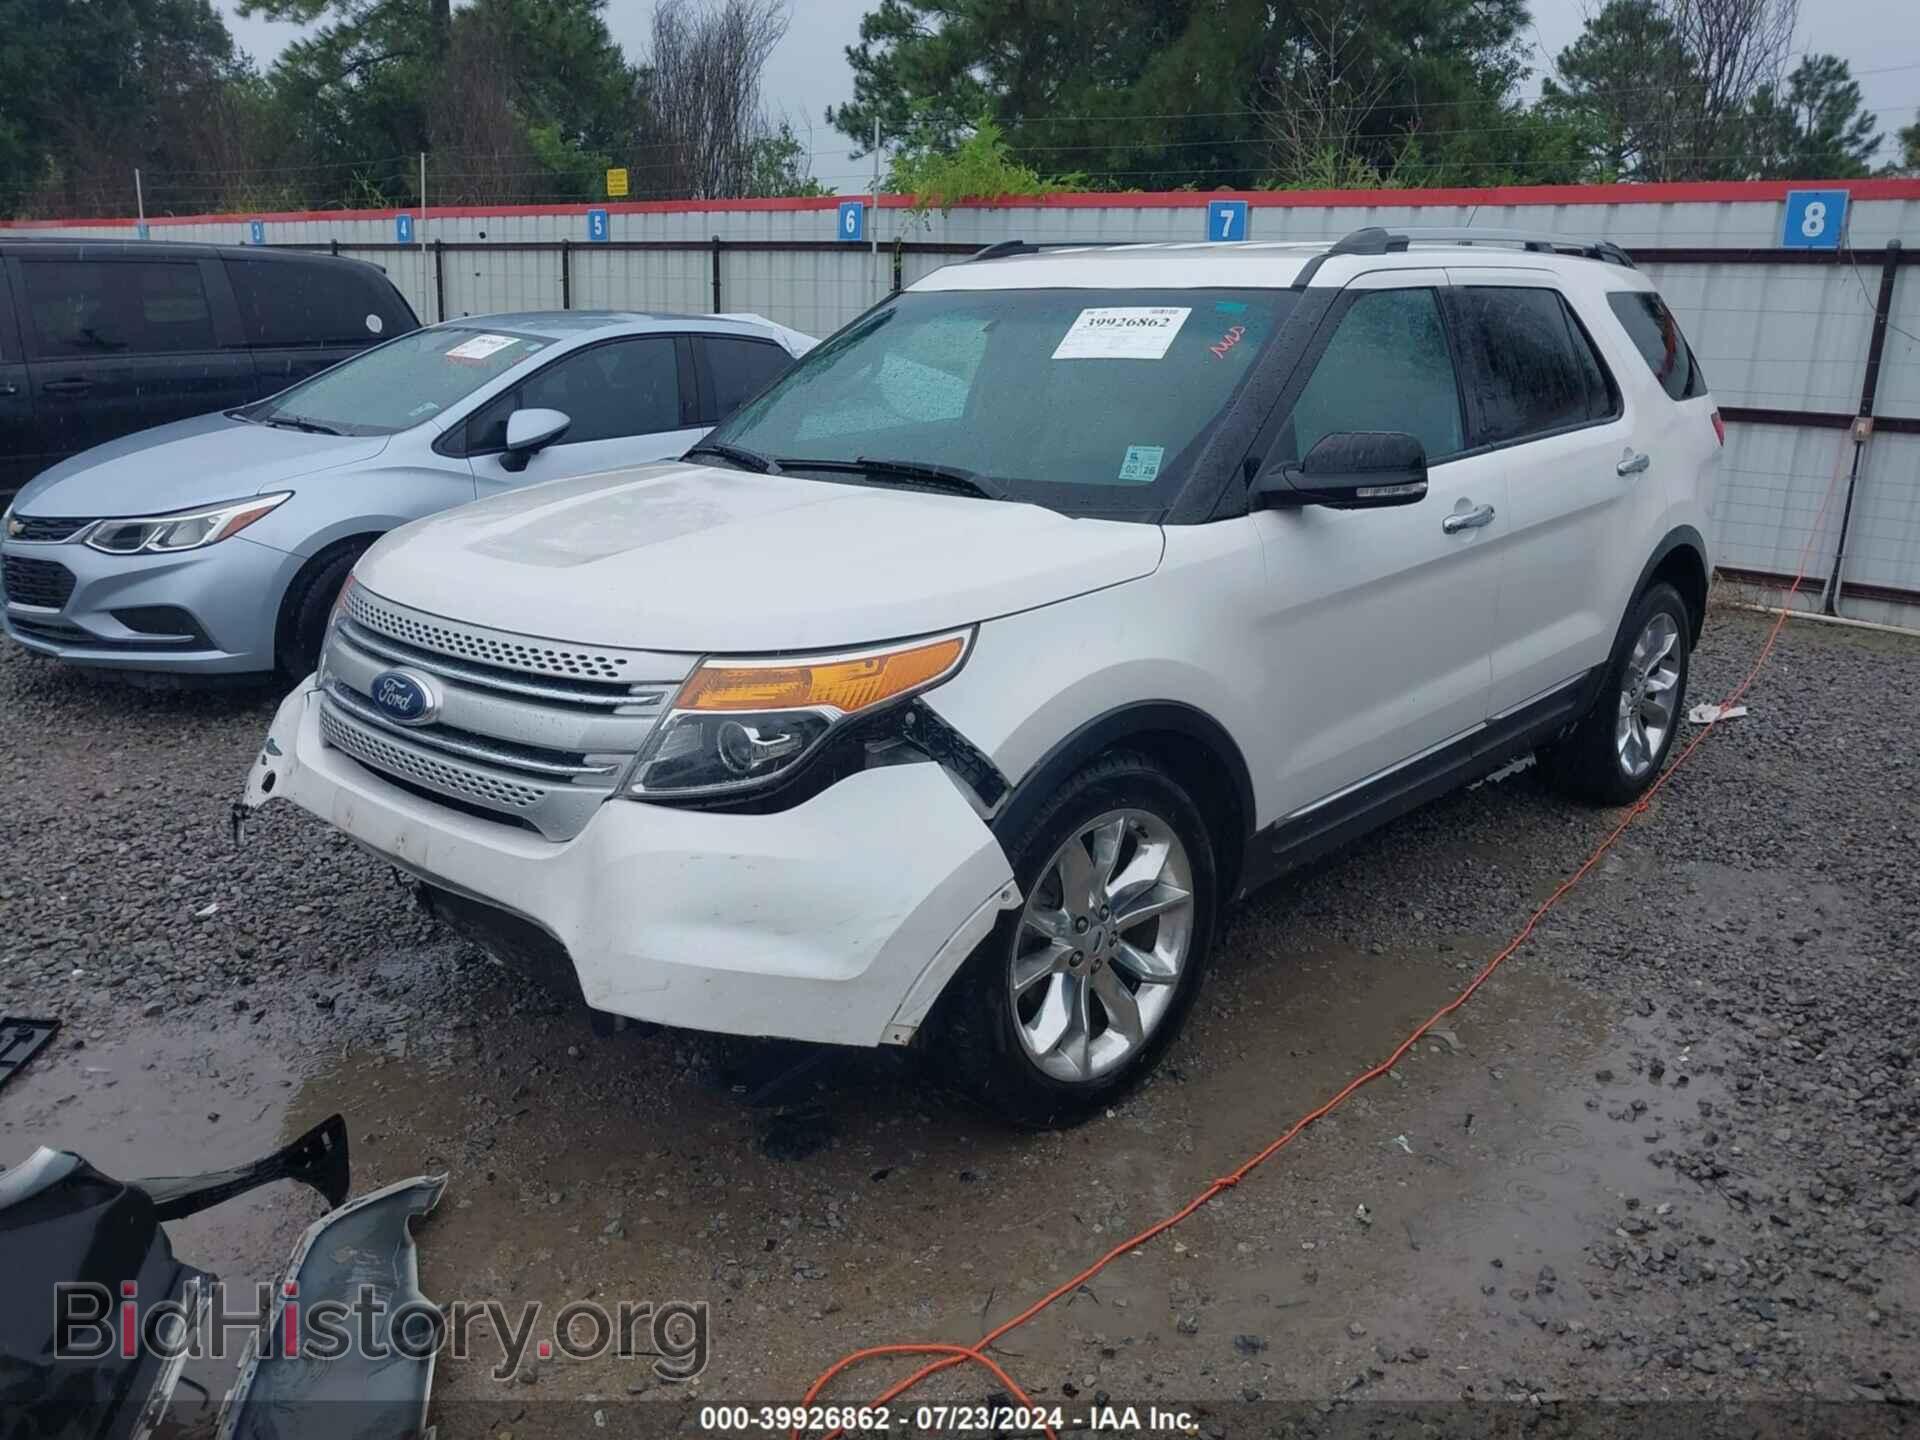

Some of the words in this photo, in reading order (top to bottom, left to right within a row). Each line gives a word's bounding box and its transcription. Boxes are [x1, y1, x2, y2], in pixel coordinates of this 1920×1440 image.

[400, 220, 407, 238] 4
[594, 216, 603, 236] 5
[845, 209, 856, 233] 6
[1220, 210, 1234, 238] 7
[1801, 201, 1827, 238] 8
[253, 224, 261, 241] 3
[1083, 316, 1171, 328] 39926862
[378, 677, 413, 711] Ford
